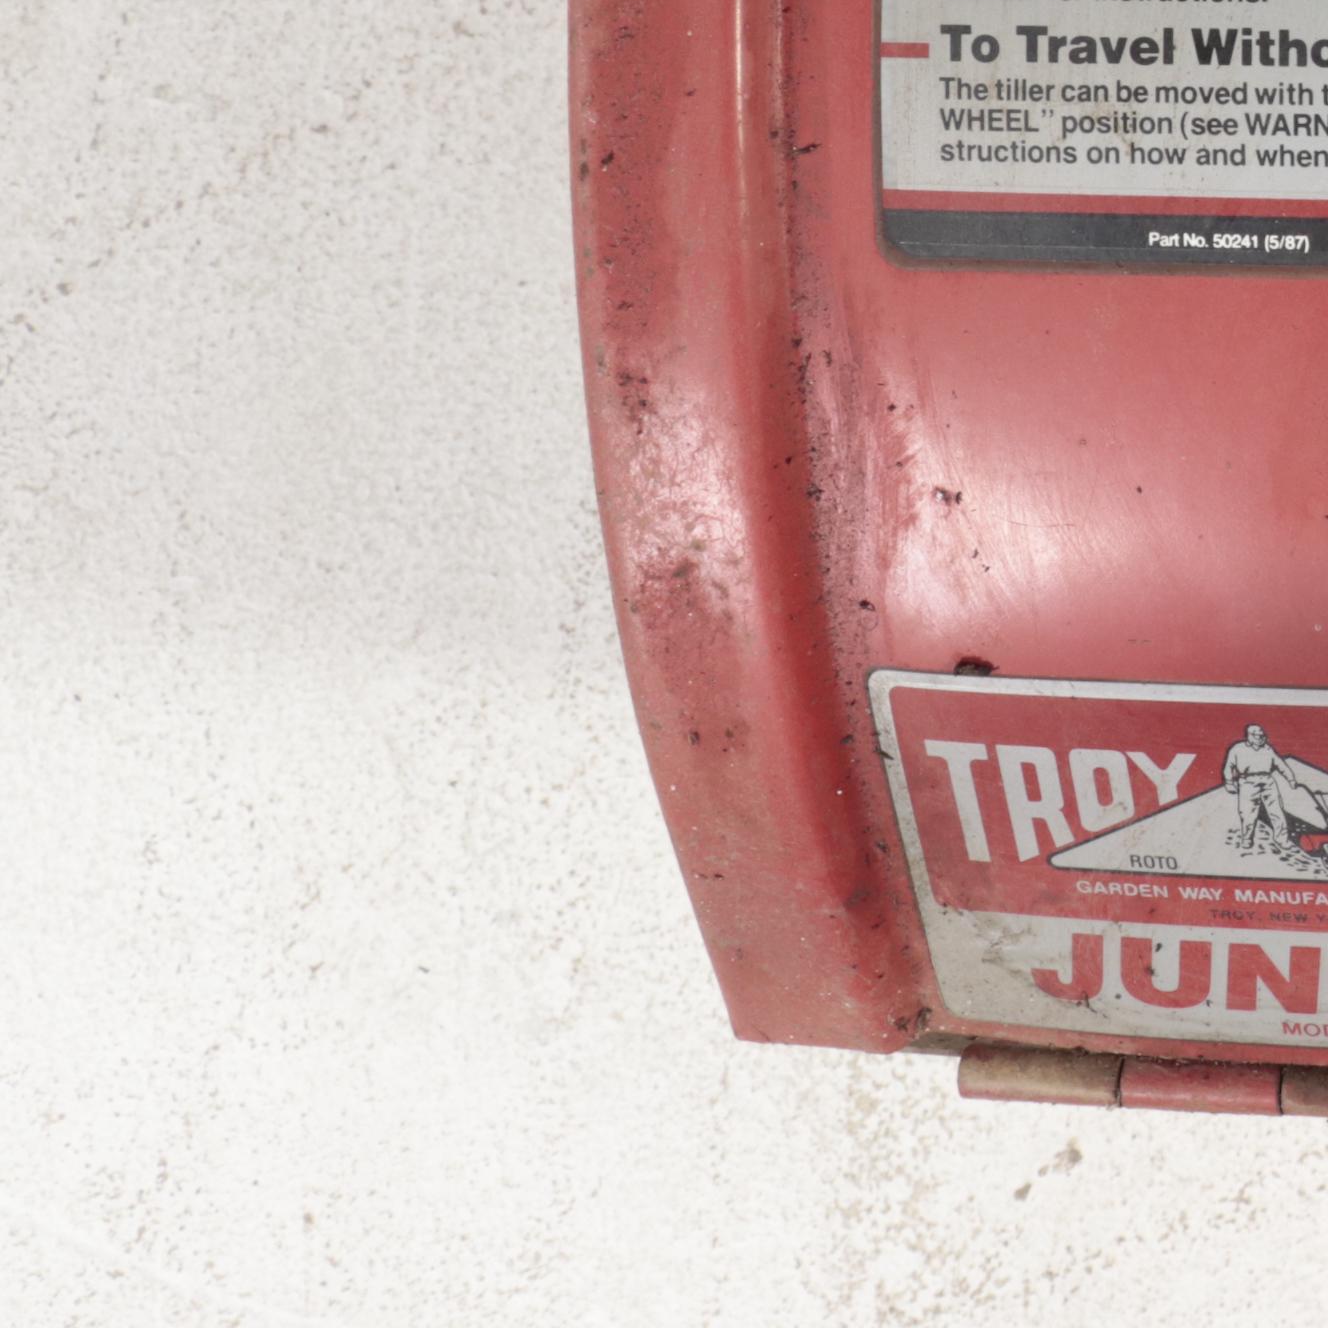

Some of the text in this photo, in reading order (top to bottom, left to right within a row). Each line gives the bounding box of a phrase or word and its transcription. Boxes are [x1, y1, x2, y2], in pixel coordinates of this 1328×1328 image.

[940, 24, 1000, 62] To
[1016, 26, 1176, 65] Travel
[1149, 232, 1309, 253] Part No. 50241 (5/87)
[924, 740, 1196, 863] TROY
[1130, 855, 1178, 870] ROTO
[1076, 880, 1168, 898] GARDEN
[1178, 887, 1222, 900] WAY
[1269, 912, 1307, 923] NEW
